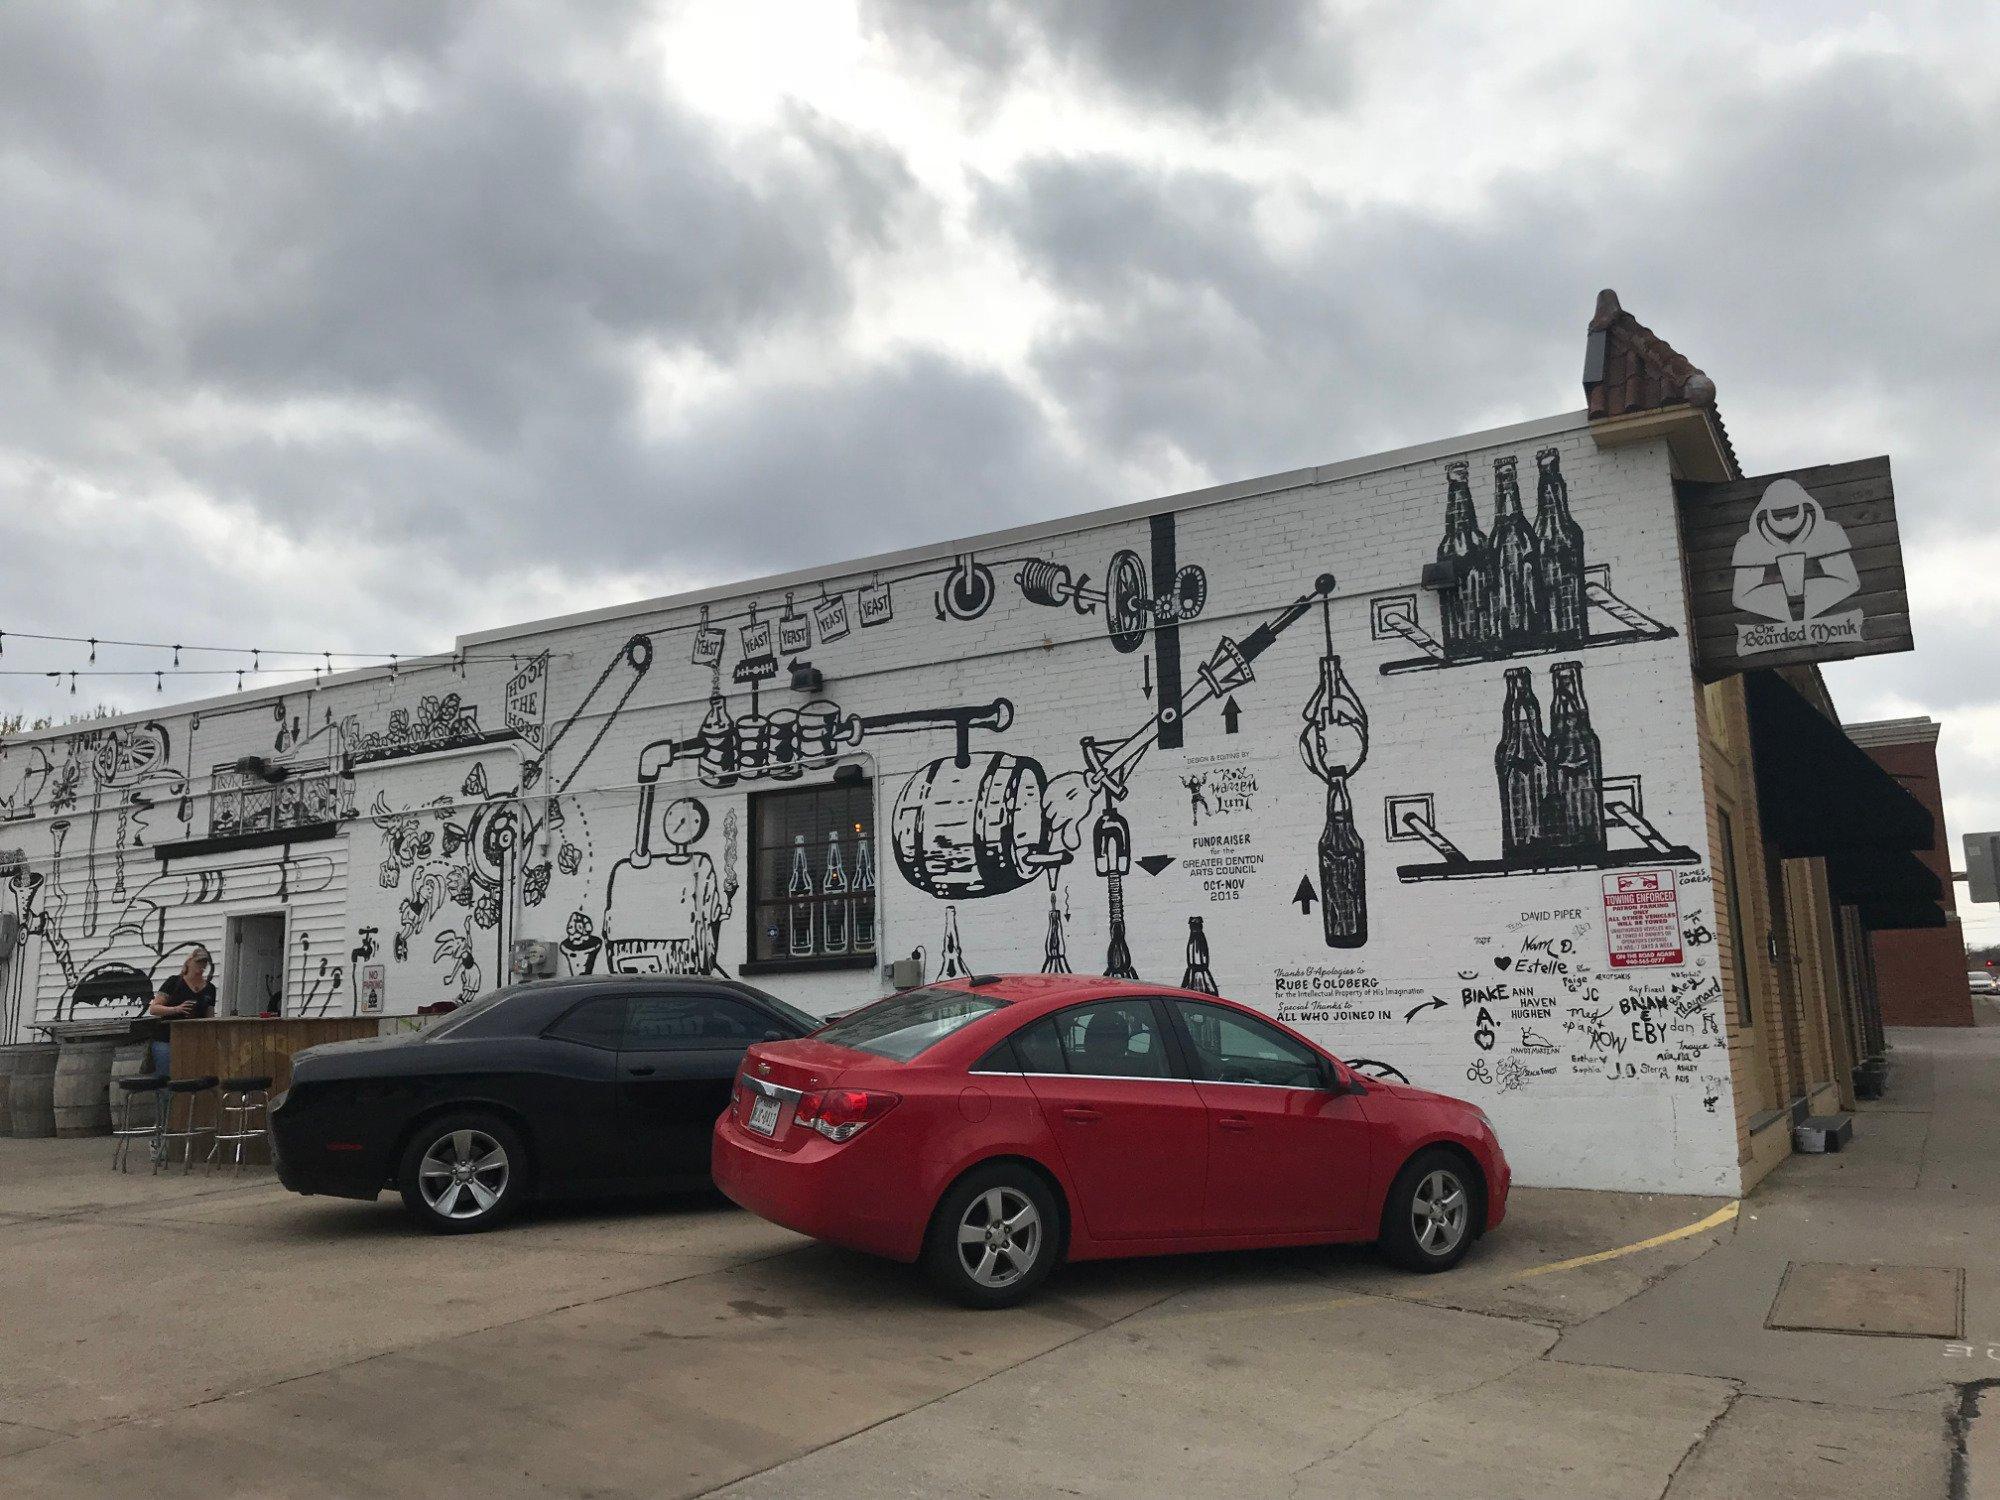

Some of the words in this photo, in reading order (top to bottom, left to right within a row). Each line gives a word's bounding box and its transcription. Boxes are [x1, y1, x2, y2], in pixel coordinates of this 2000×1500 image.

[861, 595, 889, 618] YEAST
[820, 608, 844, 632] YEAST
[1743, 625, 1806, 647] Bearded
[1810, 620, 1857, 646] Monk
[1753, 624, 1775, 635] The
[744, 631, 769, 654] YEAST
[781, 628, 806, 645] YEAST
[697, 638, 720, 656] YEAST
[510, 691, 537, 715] THE
[508, 712, 540, 743] HOPS
[1187, 755, 1209, 765] DESIGN
[1217, 752, 1240, 762] EDITING
[1241, 751, 1250, 759] BY
[1193, 833, 1251, 848] FUNDRAISER
[1182, 857, 1223, 869] GREATER
[1225, 854, 1264, 866] DENTON
[1190, 866, 1214, 877] ARTS
[1216, 864, 1257, 876] COUNCIL
[1679, 868, 1706, 878] JAMES
[1203, 879, 1245, 891] OCT-NOV
[1210, 891, 1239, 901] 2015
[1605, 894, 1635, 906] TOWING
[1636, 891, 1674, 902] ENFORCED
[1640, 902, 1669, 910] PARKING
[1521, 911, 1550, 921] DAVID
[1554, 909, 1581, 919] PIPER
[1274, 967, 1305, 978] Thanks
[1315, 967, 1356, 978] Apologies
[1515, 958, 1568, 975] Estelle
[369, 970, 378, 980] NO
[1562, 975, 1587, 988] Paige
[1275, 978, 1308, 990] RUBE
[1312, 977, 1379, 990] GOLDBERG
[1275, 991, 1283, 999] for
[1286, 990, 1296, 998] the
[1298, 989, 1333, 998] Intellectual
[1335, 989, 1362, 998] Property
[1364, 988, 1371, 996] of
[1373, 988, 1384, 996] His
[1385, 987, 1424, 997] Imagination
[1512, 987, 1534, 996] ANN
[1582, 987, 1599, 1001] JC
[1674, 976, 1721, 1019] Maynard
[1278, 1001, 1308, 1012] Special
[1310, 1000, 1341, 1010] Thanks
[1344, 1001, 1353, 1009] to
[1520, 997, 1557, 1007] HAVEN
[1276, 1011, 1297, 1021] ALL
[1301, 1011, 1329, 1021] WHO
[1333, 1010, 1375, 1021] JOINED
[1378, 1010, 1392, 1020] IN
[1511, 1009, 1551, 1019] HUGHEN
[1631, 1022, 1667, 1044] EBY
